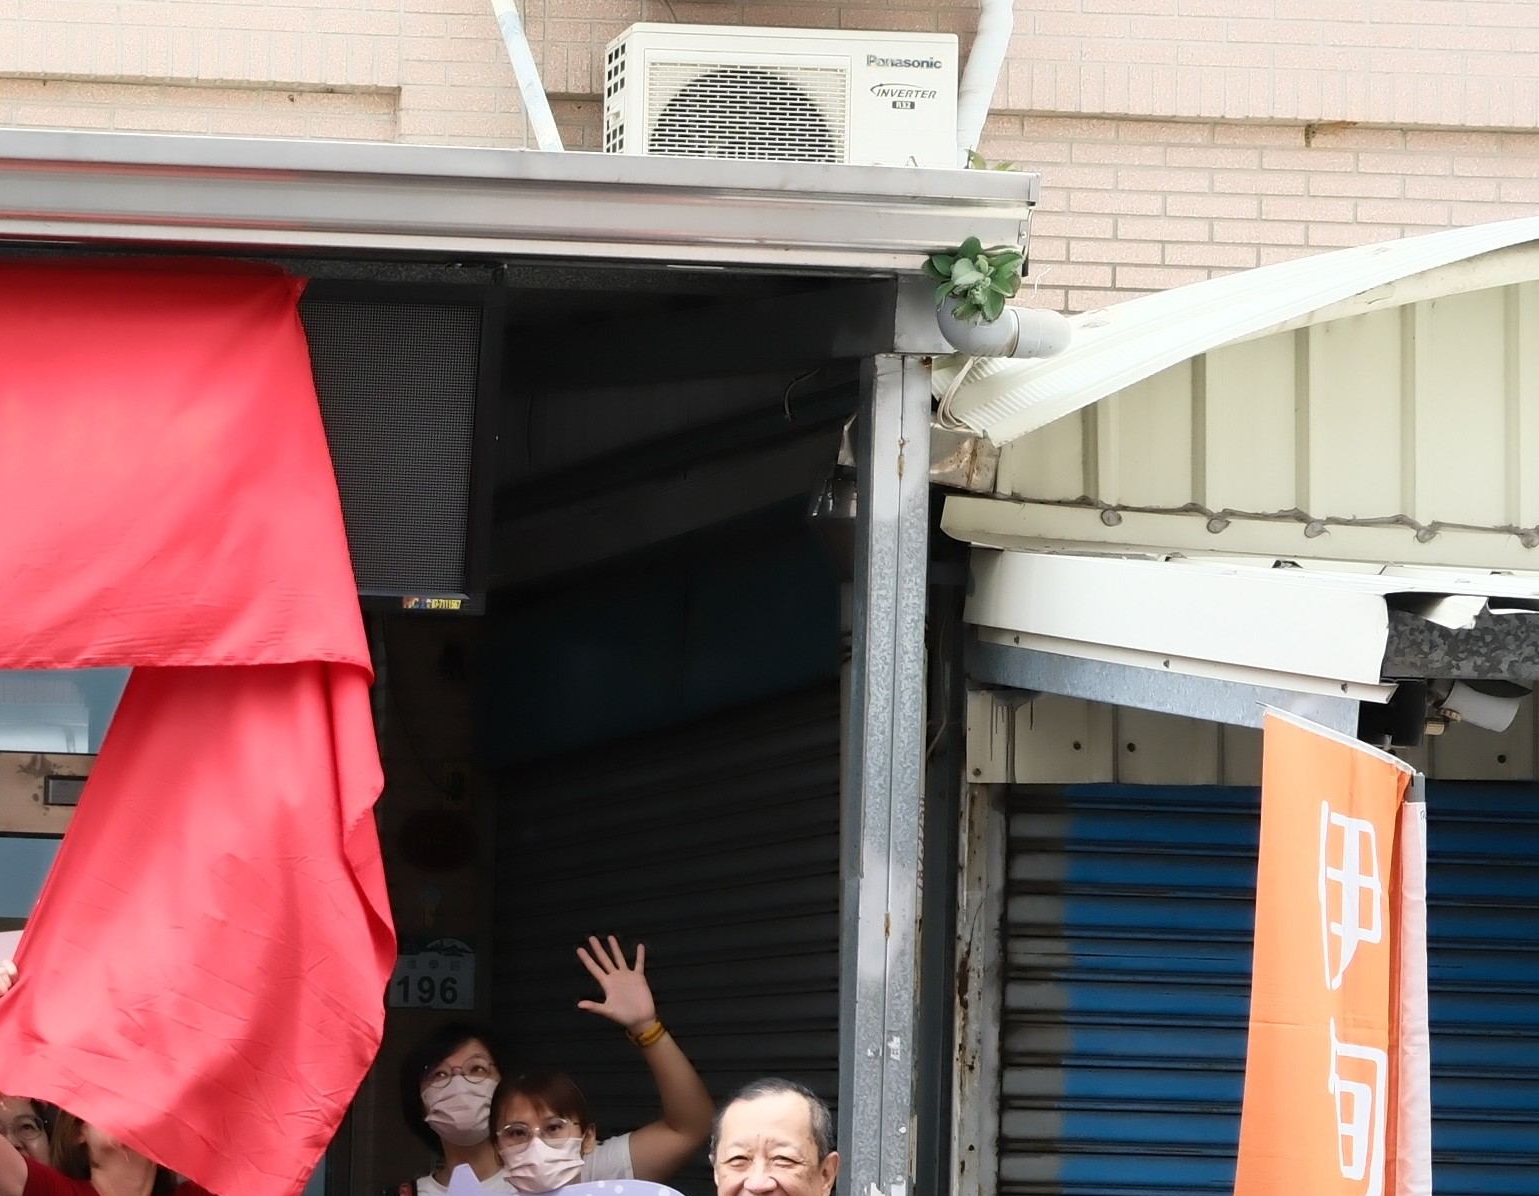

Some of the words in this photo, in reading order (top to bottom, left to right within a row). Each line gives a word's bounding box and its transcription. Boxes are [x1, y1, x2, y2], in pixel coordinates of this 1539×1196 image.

[866, 54, 942, 69] Panasonic
[876, 88, 938, 100] INVERTER
[397, 975, 458, 1005] 196
